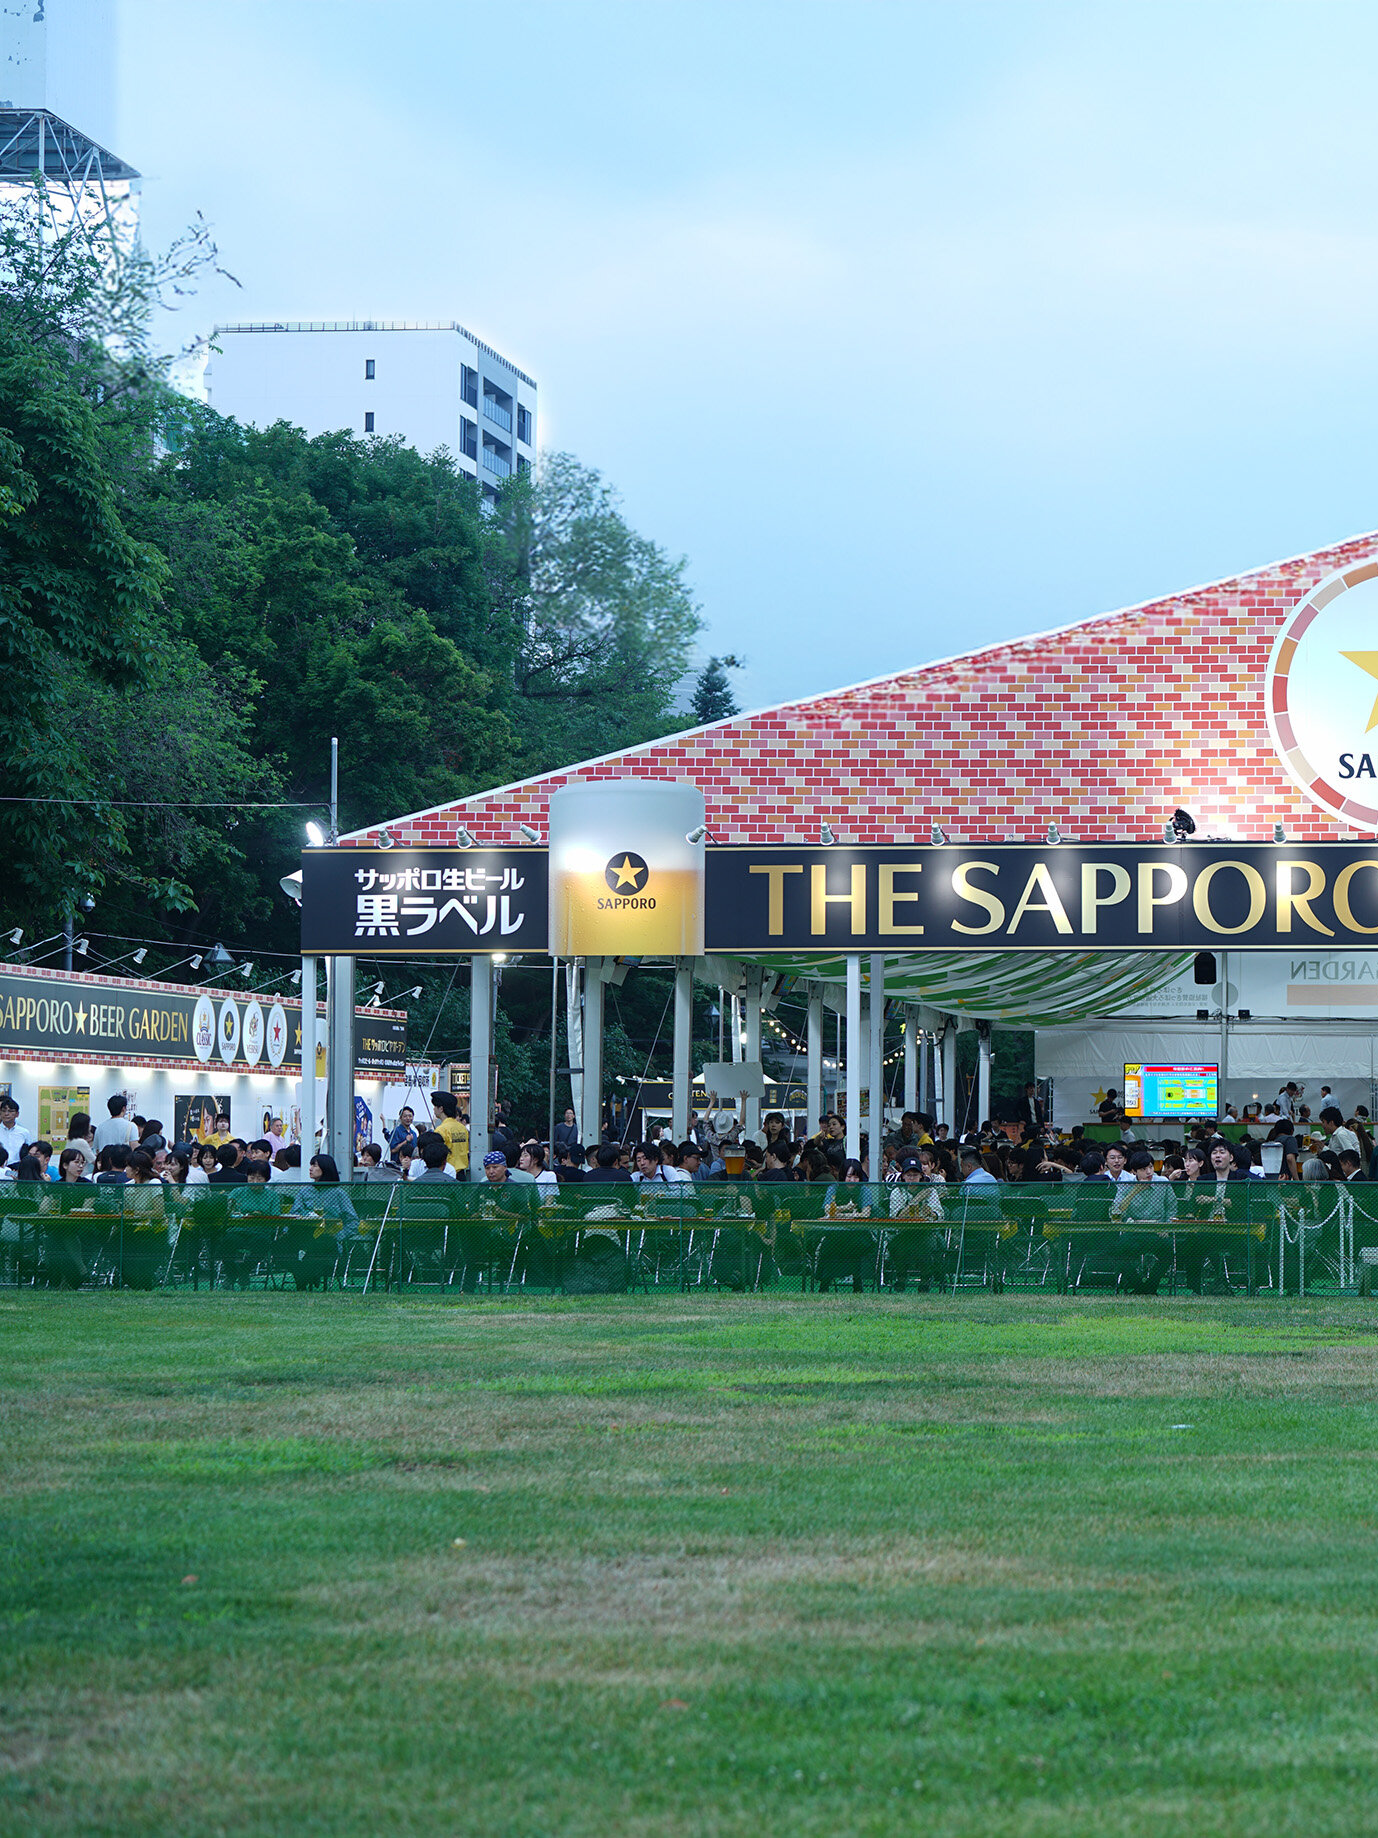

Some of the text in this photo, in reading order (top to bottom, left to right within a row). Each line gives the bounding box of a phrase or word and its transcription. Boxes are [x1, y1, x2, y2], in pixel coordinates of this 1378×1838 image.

[354, 868, 525, 891] サッポロ生ビール
[354, 895, 525, 936] 黒ラベル
[597, 898, 656, 910] SAPPORO
[749, 864, 924, 935] THE
[90, 1003, 126, 1040] BEER
[128, 1007, 189, 1042] GARDEN
